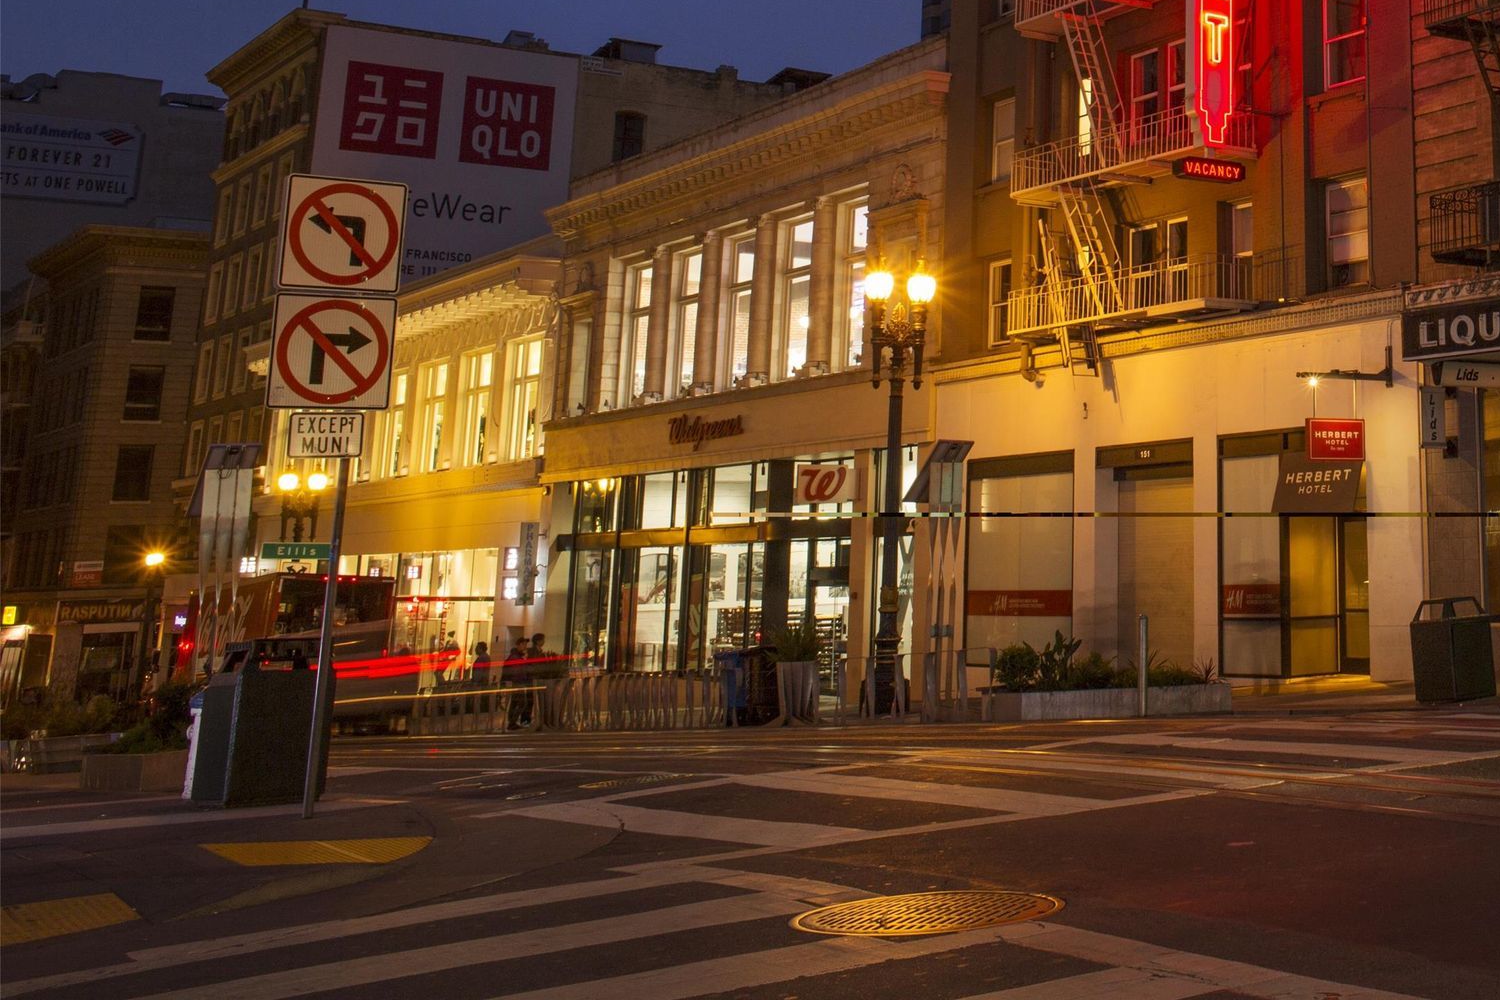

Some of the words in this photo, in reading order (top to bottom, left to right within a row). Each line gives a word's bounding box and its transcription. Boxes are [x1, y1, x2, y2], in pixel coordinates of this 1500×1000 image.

[475, 88, 540, 123] UNI
[40, 125, 92, 140] America
[471, 125, 542, 162] QLO
[7, 146, 82, 166] FOREVER
[94, 154, 112, 168] 21
[1184, 160, 1240, 180] VACANCY
[25, 177, 38, 187] AT
[44, 175, 71, 190] ONE
[76, 179, 128, 194] POWELL
[406, 249, 472, 262] FRANCISCO
[1455, 367, 1480, 383] Lids
[298, 417, 356, 433] EXCEPT
[1429, 394, 1438, 441] Lids
[1314, 431, 1359, 439] HERBERT
[301, 437, 349, 453] MUNI
[1286, 469, 1352, 484] HERBERT
[1298, 485, 1332, 494] HOTEL
[277, 546, 316, 556] Ellis
[61, 604, 131, 620] RASPUTIN
